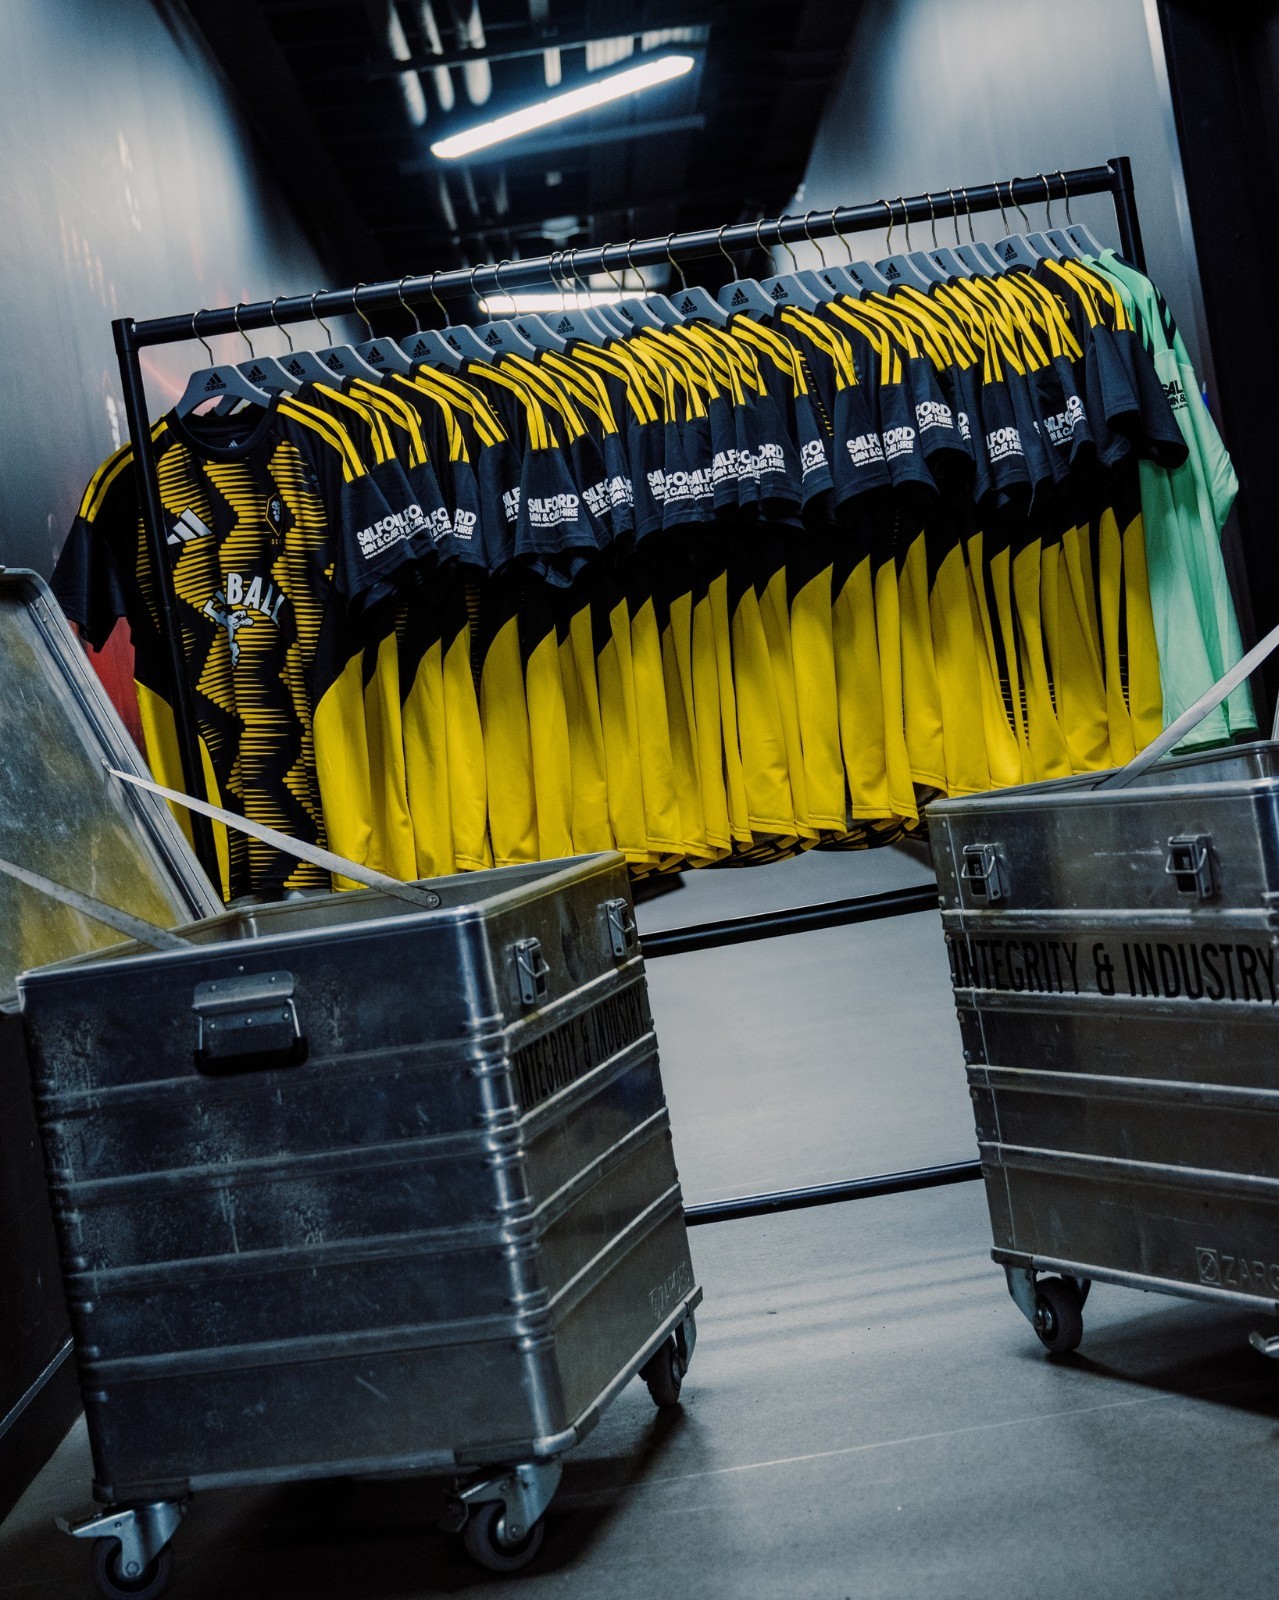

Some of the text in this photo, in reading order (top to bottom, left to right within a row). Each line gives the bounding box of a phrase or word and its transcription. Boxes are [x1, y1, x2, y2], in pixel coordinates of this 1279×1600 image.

[731, 298, 749, 306] adidas
[680, 306, 698, 315] adidas
[556, 326, 574, 334] adidas
[412, 348, 430, 358] adidas
[204, 382, 226, 392] adidas
[916, 400, 952, 420] FORD
[882, 426, 916, 448] FORD
[897, 440, 914, 450] HIRE
[806, 453, 825, 466] CAR
[851, 450, 869, 463] VAN
[869, 448, 876, 457] &
[728, 464, 736, 473] &
[670, 485, 689, 496] CAR
[528, 494, 579, 513] SALFORD
[599, 499, 608, 508] &
[542, 513, 549, 522] &
[560, 508, 578, 516] HIRE
[357, 514, 398, 546] SALFO
[405, 525, 411, 534] &
[454, 523, 474, 535] HIRE
[361, 541, 377, 556] VAN
[376, 538, 385, 547] &
[383, 528, 400, 542] CAR
[950, 938, 1275, 1005] INTEGRITY & INDUSTRY
[514, 981, 645, 1110] INTEGRITY & INDUSTRY
